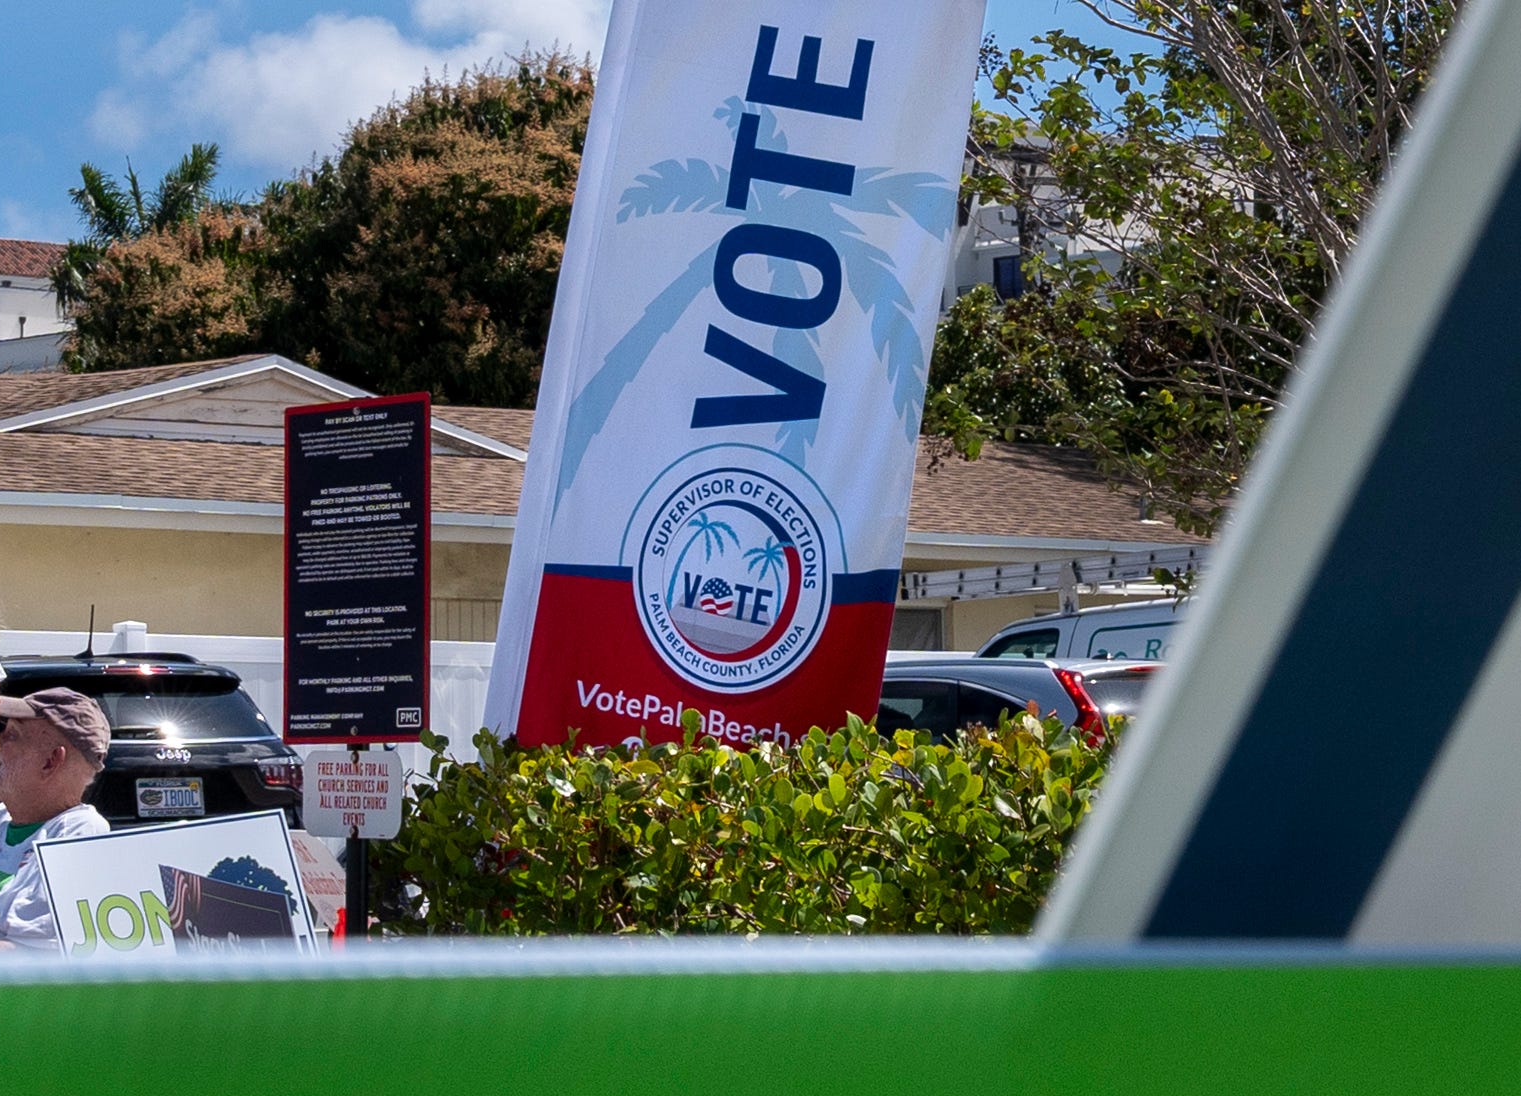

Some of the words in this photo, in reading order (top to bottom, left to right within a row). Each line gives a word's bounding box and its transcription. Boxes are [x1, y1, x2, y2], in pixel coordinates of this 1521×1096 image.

[690, 25, 875, 430] VOTE
[652, 479, 735, 557] SUPERVISOR
[740, 481, 765, 499] OF
[764, 491, 816, 589] ELECTIONS
[649, 593, 670, 633] PALM
[666, 631, 701, 668] BEACH
[702, 661, 758, 678] COUNTY,
[759, 624, 805, 670] FLORIDA
[400, 712, 418, 722] PMC
[156, 748, 191, 764] Jeep
[317, 762, 334, 776] FREE
[336, 762, 364, 777] PARKING
[365, 763, 377, 777] FOR
[378, 763, 389, 777] ALL
[317, 779, 344, 793] CHURCH
[346, 780, 375, 793] SERVICES
[376, 780, 389, 794] AND
[319, 794, 332, 809] ALL
[334, 795, 361, 809] RELATED
[363, 796, 387, 810] CHURCH
[342, 812, 365, 827] EVENTS
